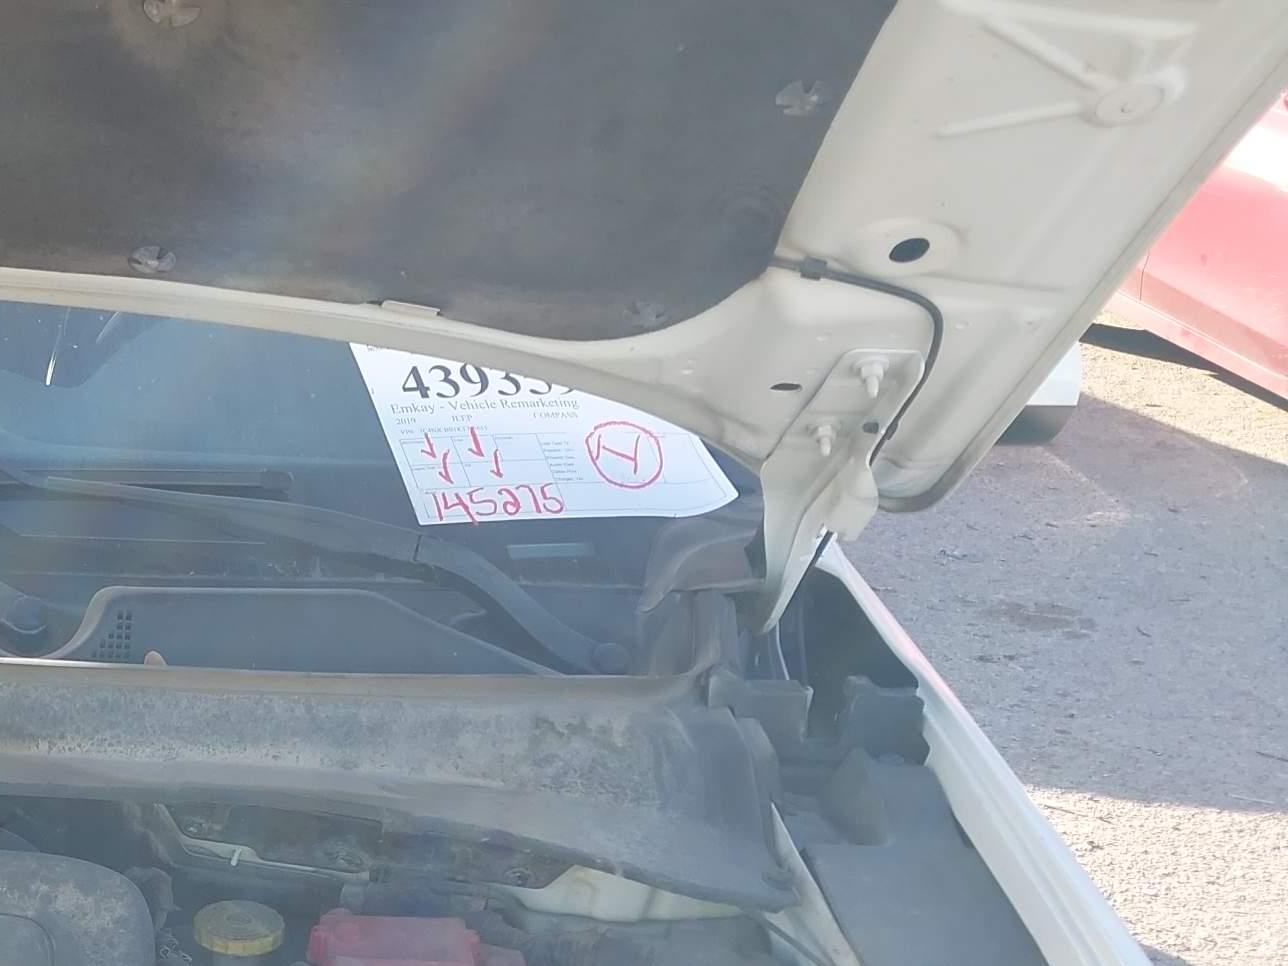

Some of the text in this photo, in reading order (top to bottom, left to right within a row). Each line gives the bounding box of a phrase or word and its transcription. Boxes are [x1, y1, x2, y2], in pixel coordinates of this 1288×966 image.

[402, 363, 574, 399] 4393
[390, 402, 435, 415] Emkay
[448, 400, 497, 411] Vehicle
[498, 397, 580, 411] Remarketing
[396, 417, 417, 425] 2019
